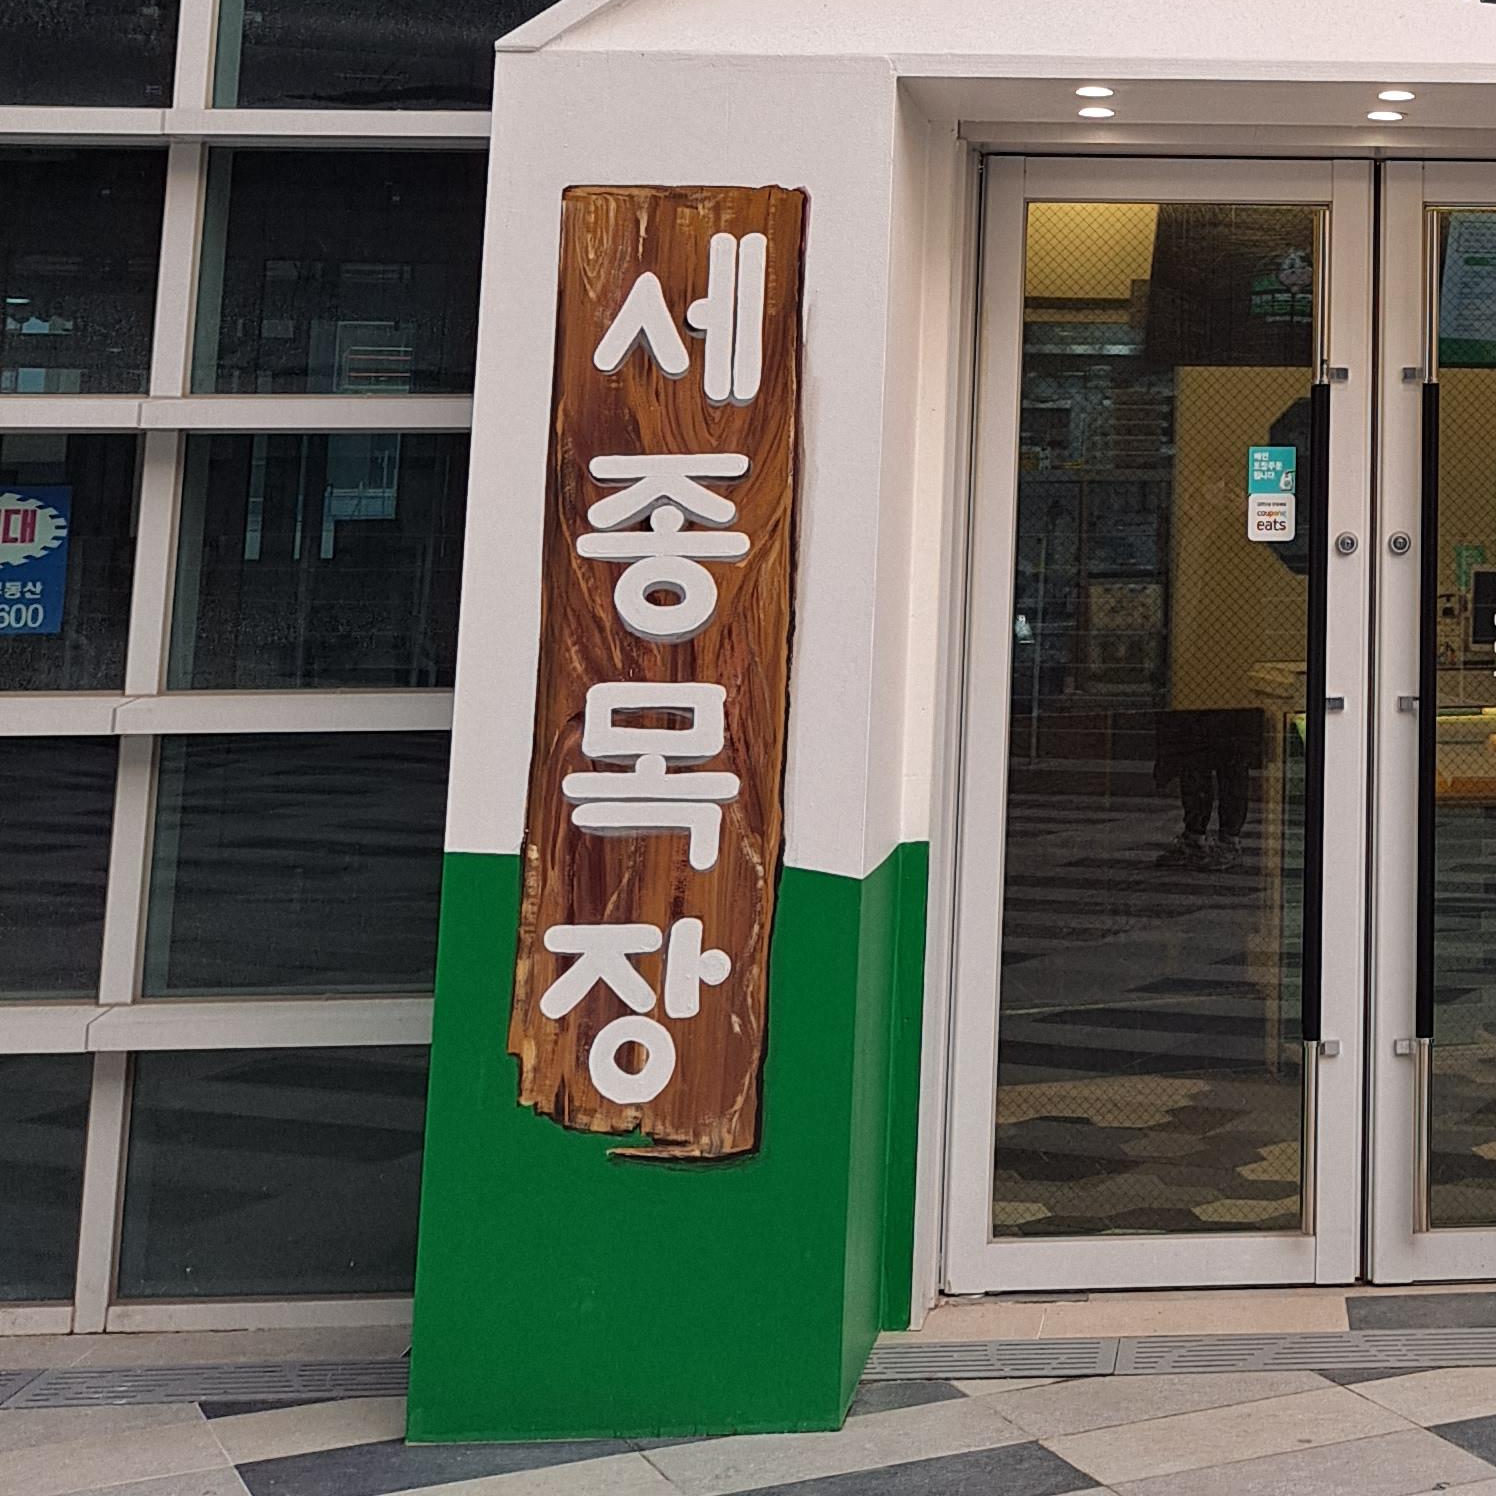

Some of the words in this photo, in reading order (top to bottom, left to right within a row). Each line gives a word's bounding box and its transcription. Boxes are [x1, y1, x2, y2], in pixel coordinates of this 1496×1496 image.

[0, 508, 38, 544] 대
[1256, 517, 1287, 531] eats
[0, 581, 43, 599] 동산
[539, 232, 768, 1104] 세종목장
